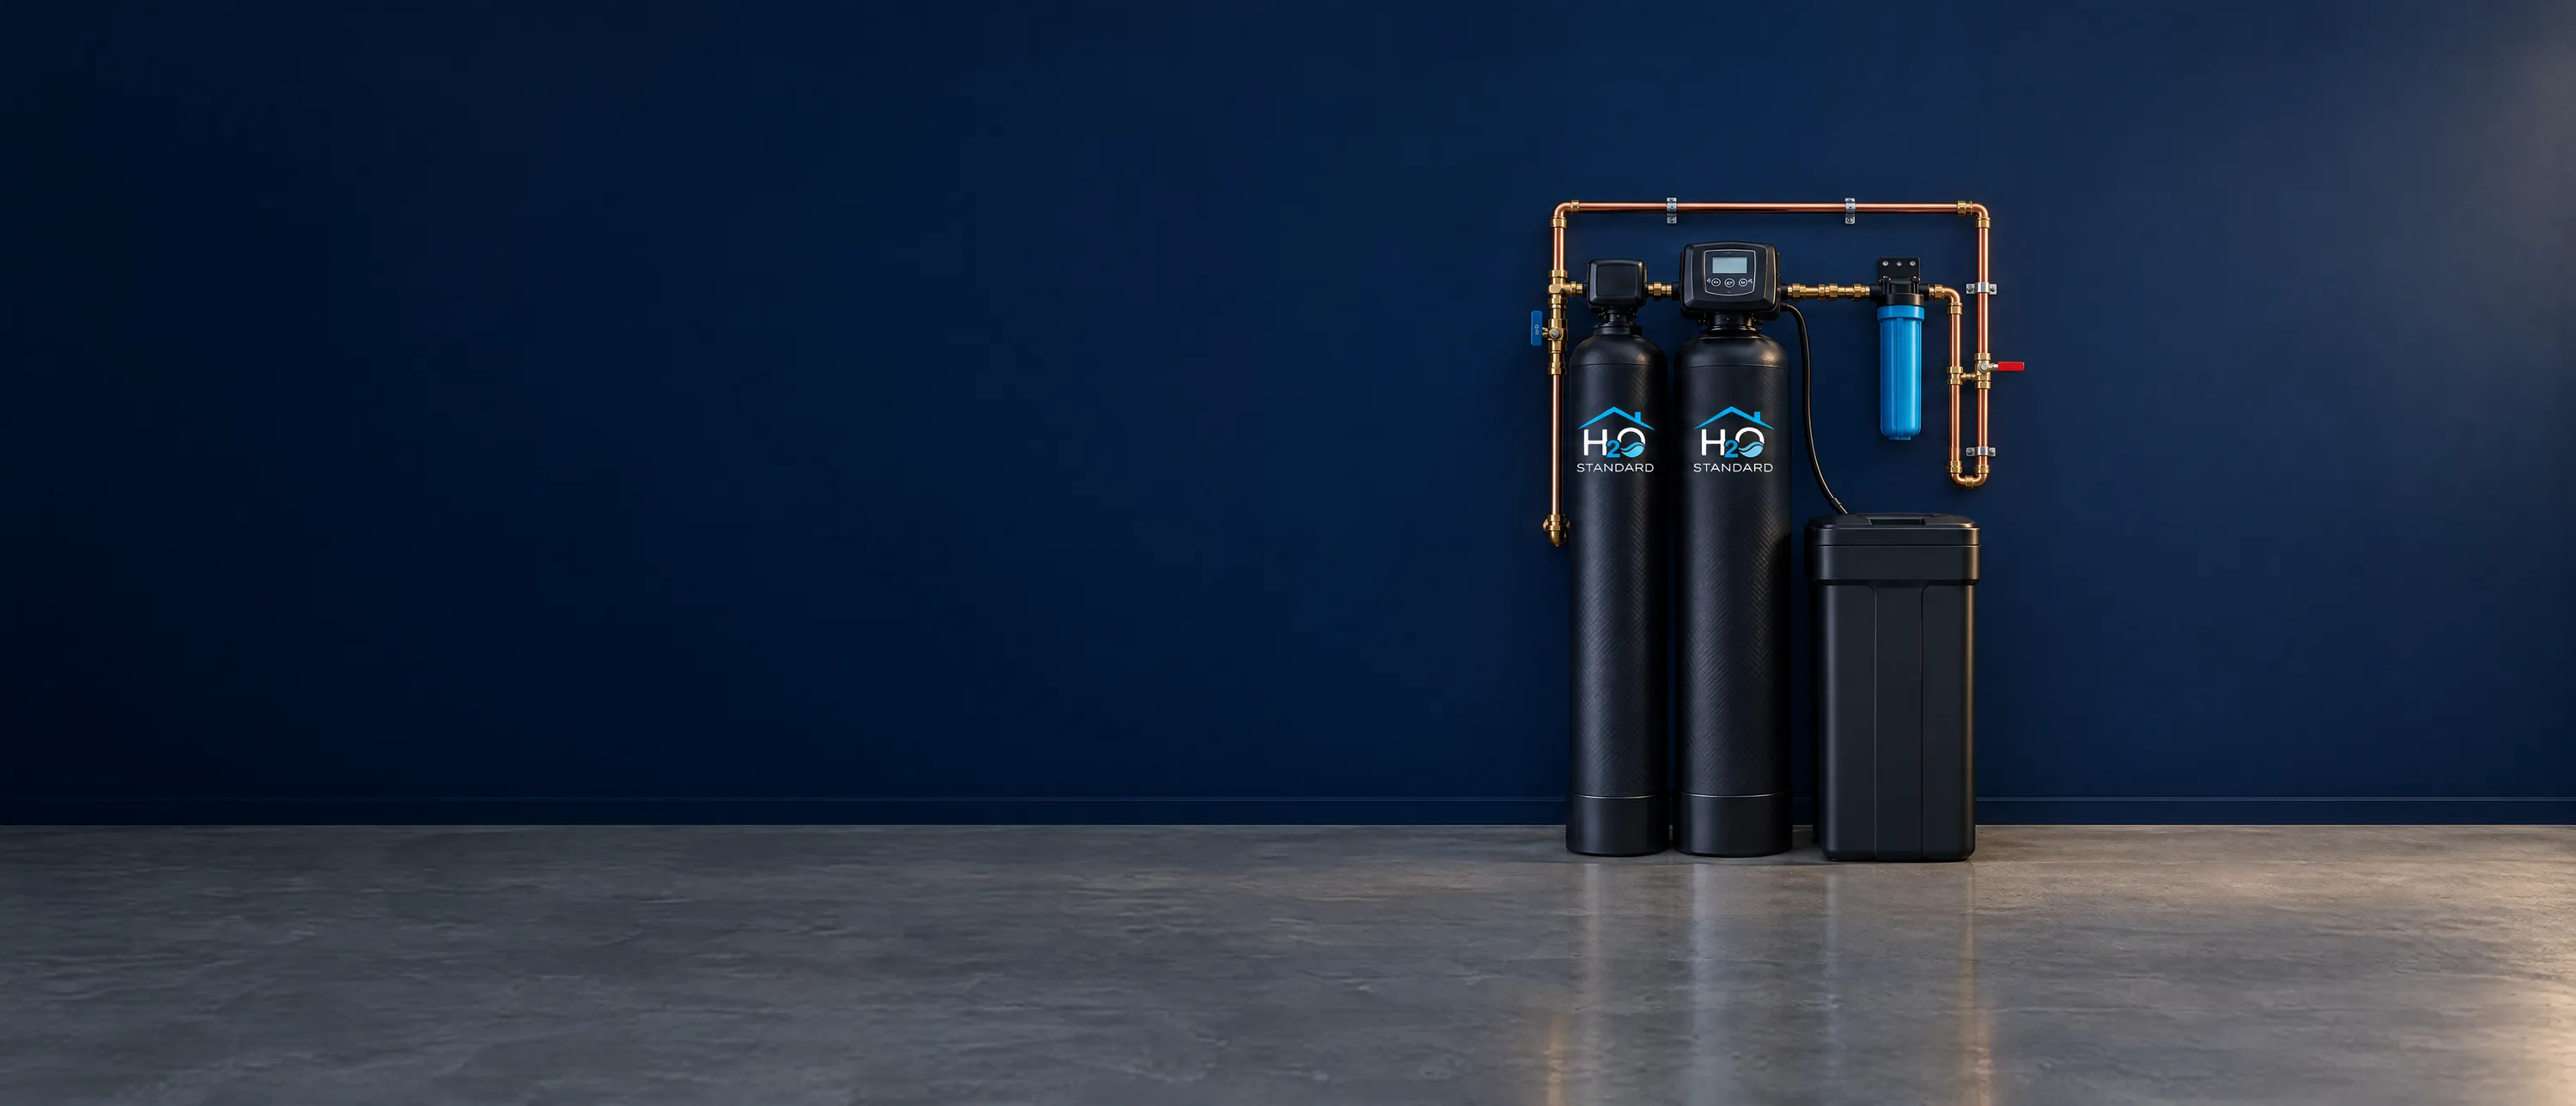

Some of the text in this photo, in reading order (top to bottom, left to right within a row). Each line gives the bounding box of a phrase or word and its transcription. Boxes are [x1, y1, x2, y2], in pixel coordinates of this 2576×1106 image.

[1583, 427, 1646, 459] H2O
[1701, 427, 1765, 459] H2O
[1577, 463, 1655, 473] STANDARD
[1693, 463, 1773, 473] STANDARD
